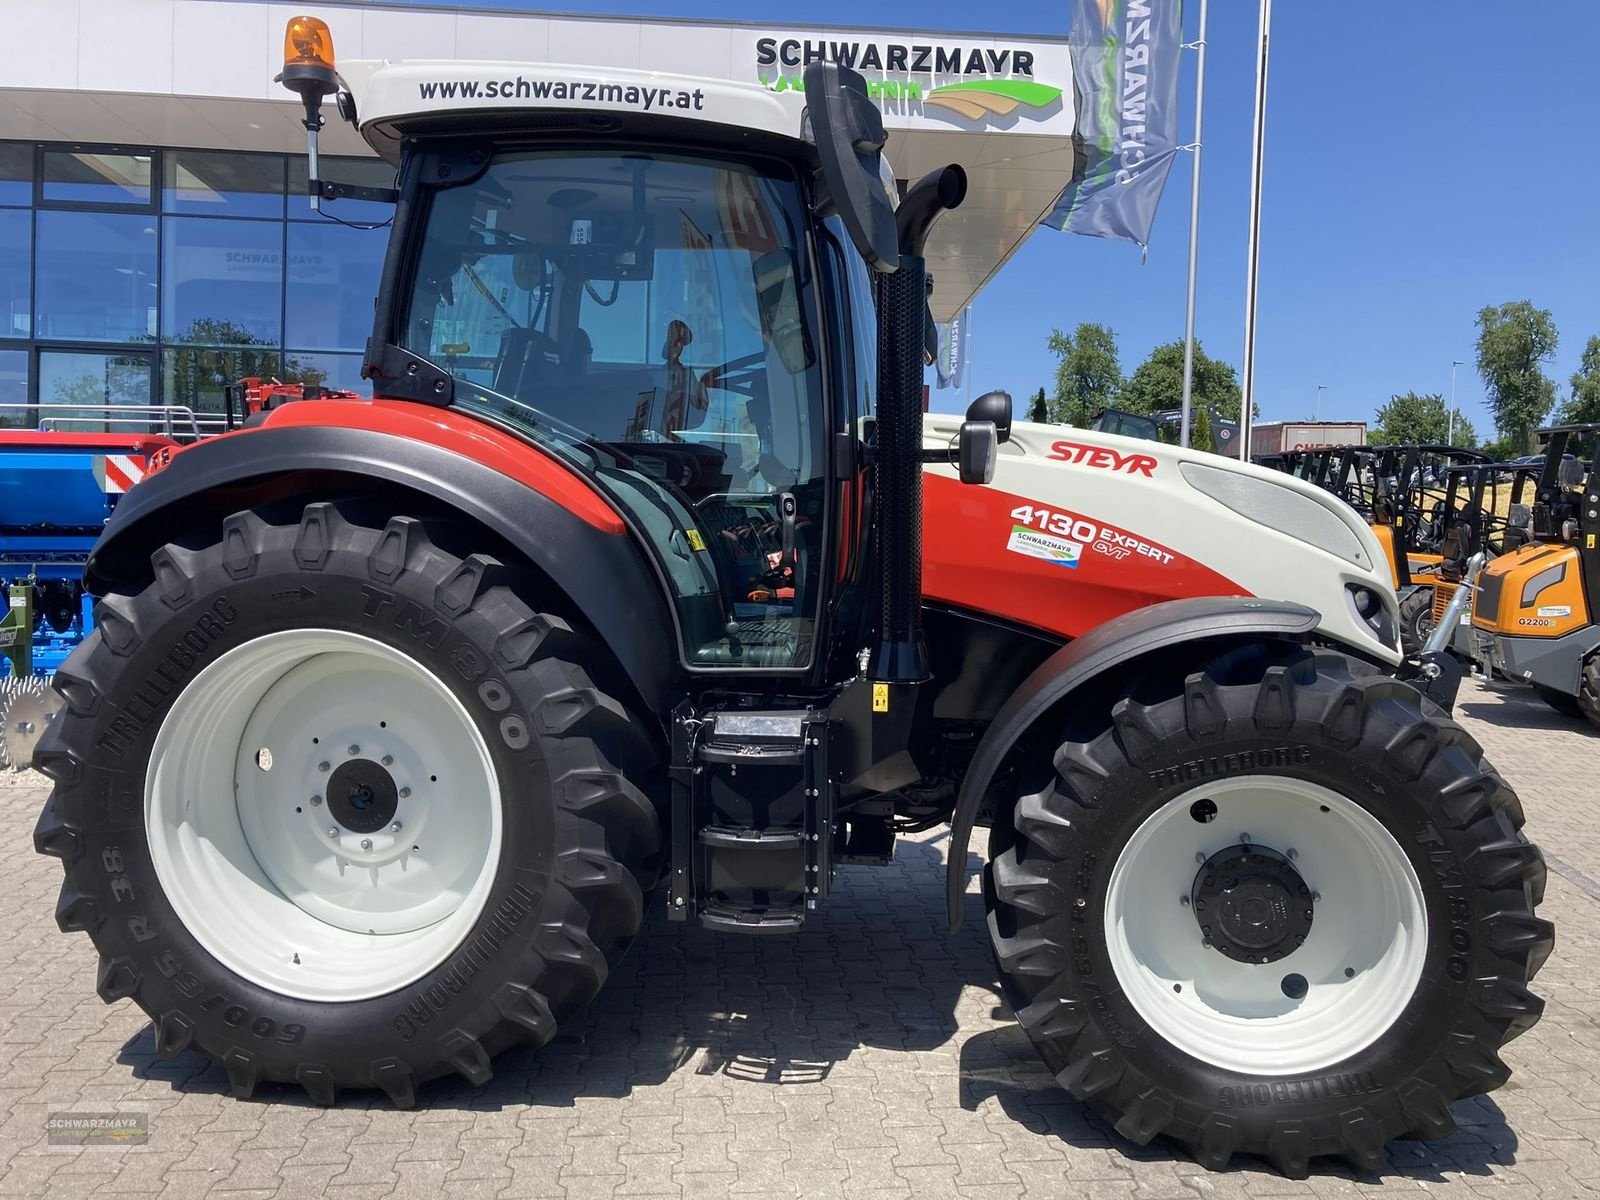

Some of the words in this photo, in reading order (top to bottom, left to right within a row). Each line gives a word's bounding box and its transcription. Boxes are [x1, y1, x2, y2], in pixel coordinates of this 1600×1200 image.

[756, 38, 1034, 76] SCHWARZMAYR
[419, 76, 704, 110] www.schwarzmayr.at
[225, 252, 322, 265] SCHWARMAYR
[1046, 441, 1158, 478] STEYR
[1010, 505, 1097, 543] 4130
[1099, 528, 1174, 565] EXPERT
[1017, 533, 1072, 552] SCHWARZMAYR
[1092, 540, 1131, 560] CVT
[95, 595, 241, 759] TRELLEBORG
[1147, 744, 1313, 791] TRELLEBORG
[391, 881, 545, 1043] TRELLEBORG
[1217, 1071, 1385, 1108] TRELLEBORG
